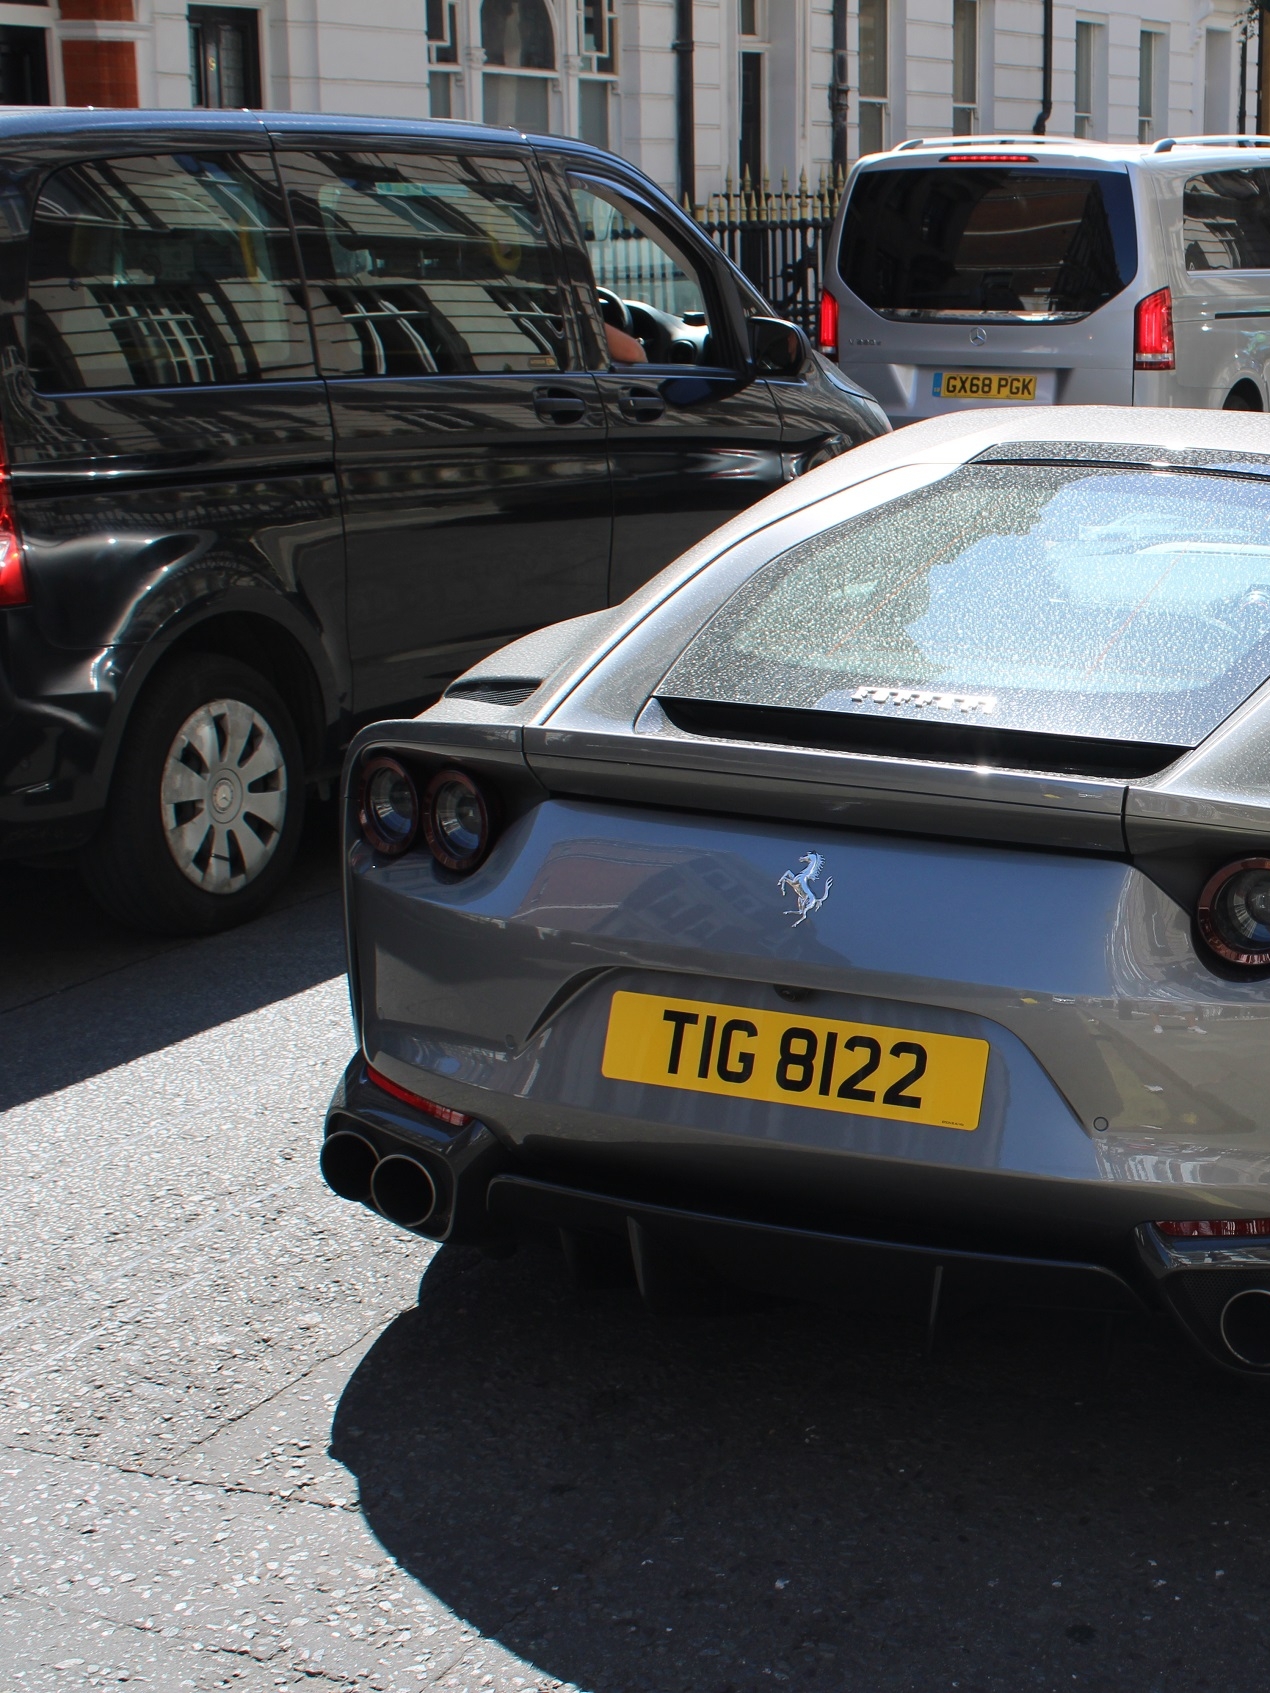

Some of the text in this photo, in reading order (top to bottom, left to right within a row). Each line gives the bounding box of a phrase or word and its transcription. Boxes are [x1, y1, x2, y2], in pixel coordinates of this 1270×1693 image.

[946, 375, 1033, 395] GX68 PGK
[662, 1009, 928, 1109] TIG 8122
